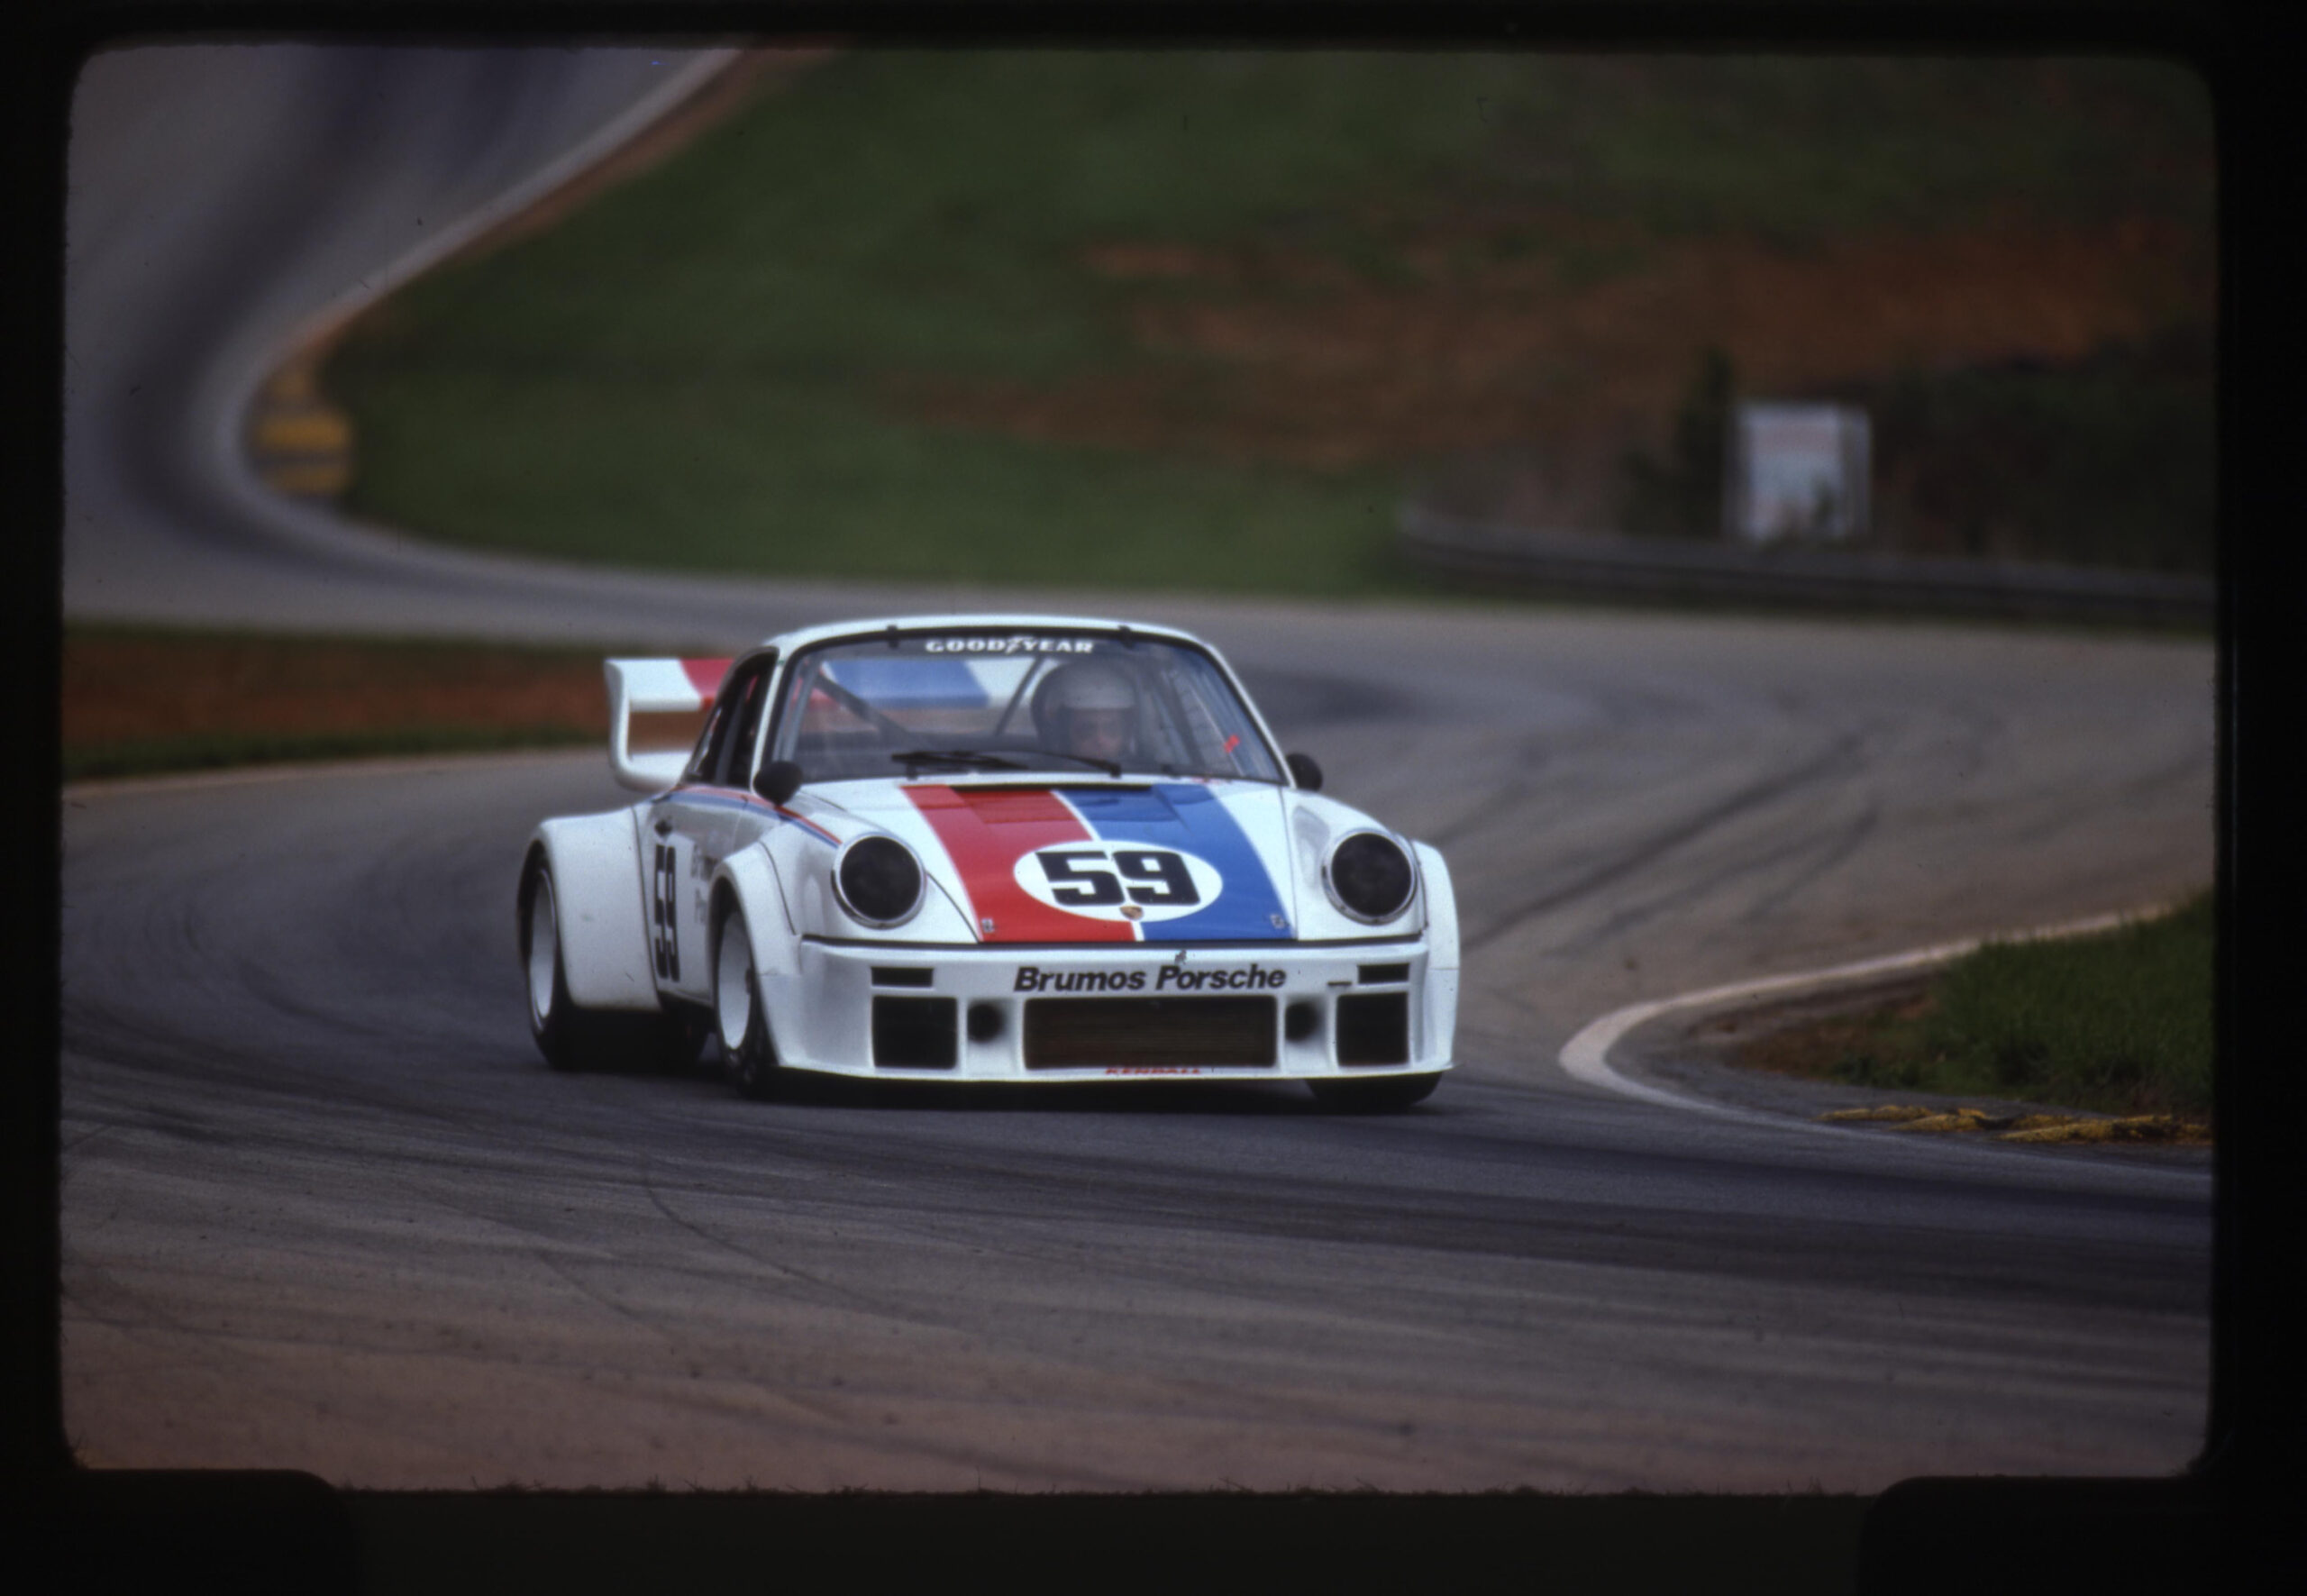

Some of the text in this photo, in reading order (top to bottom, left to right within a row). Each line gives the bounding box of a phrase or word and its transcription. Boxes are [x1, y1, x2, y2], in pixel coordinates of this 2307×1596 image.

[926, 635, 1094, 653] GOODYEAR
[1035, 850, 1200, 907] 59
[1014, 963, 1287, 992] Brumos Porsche
